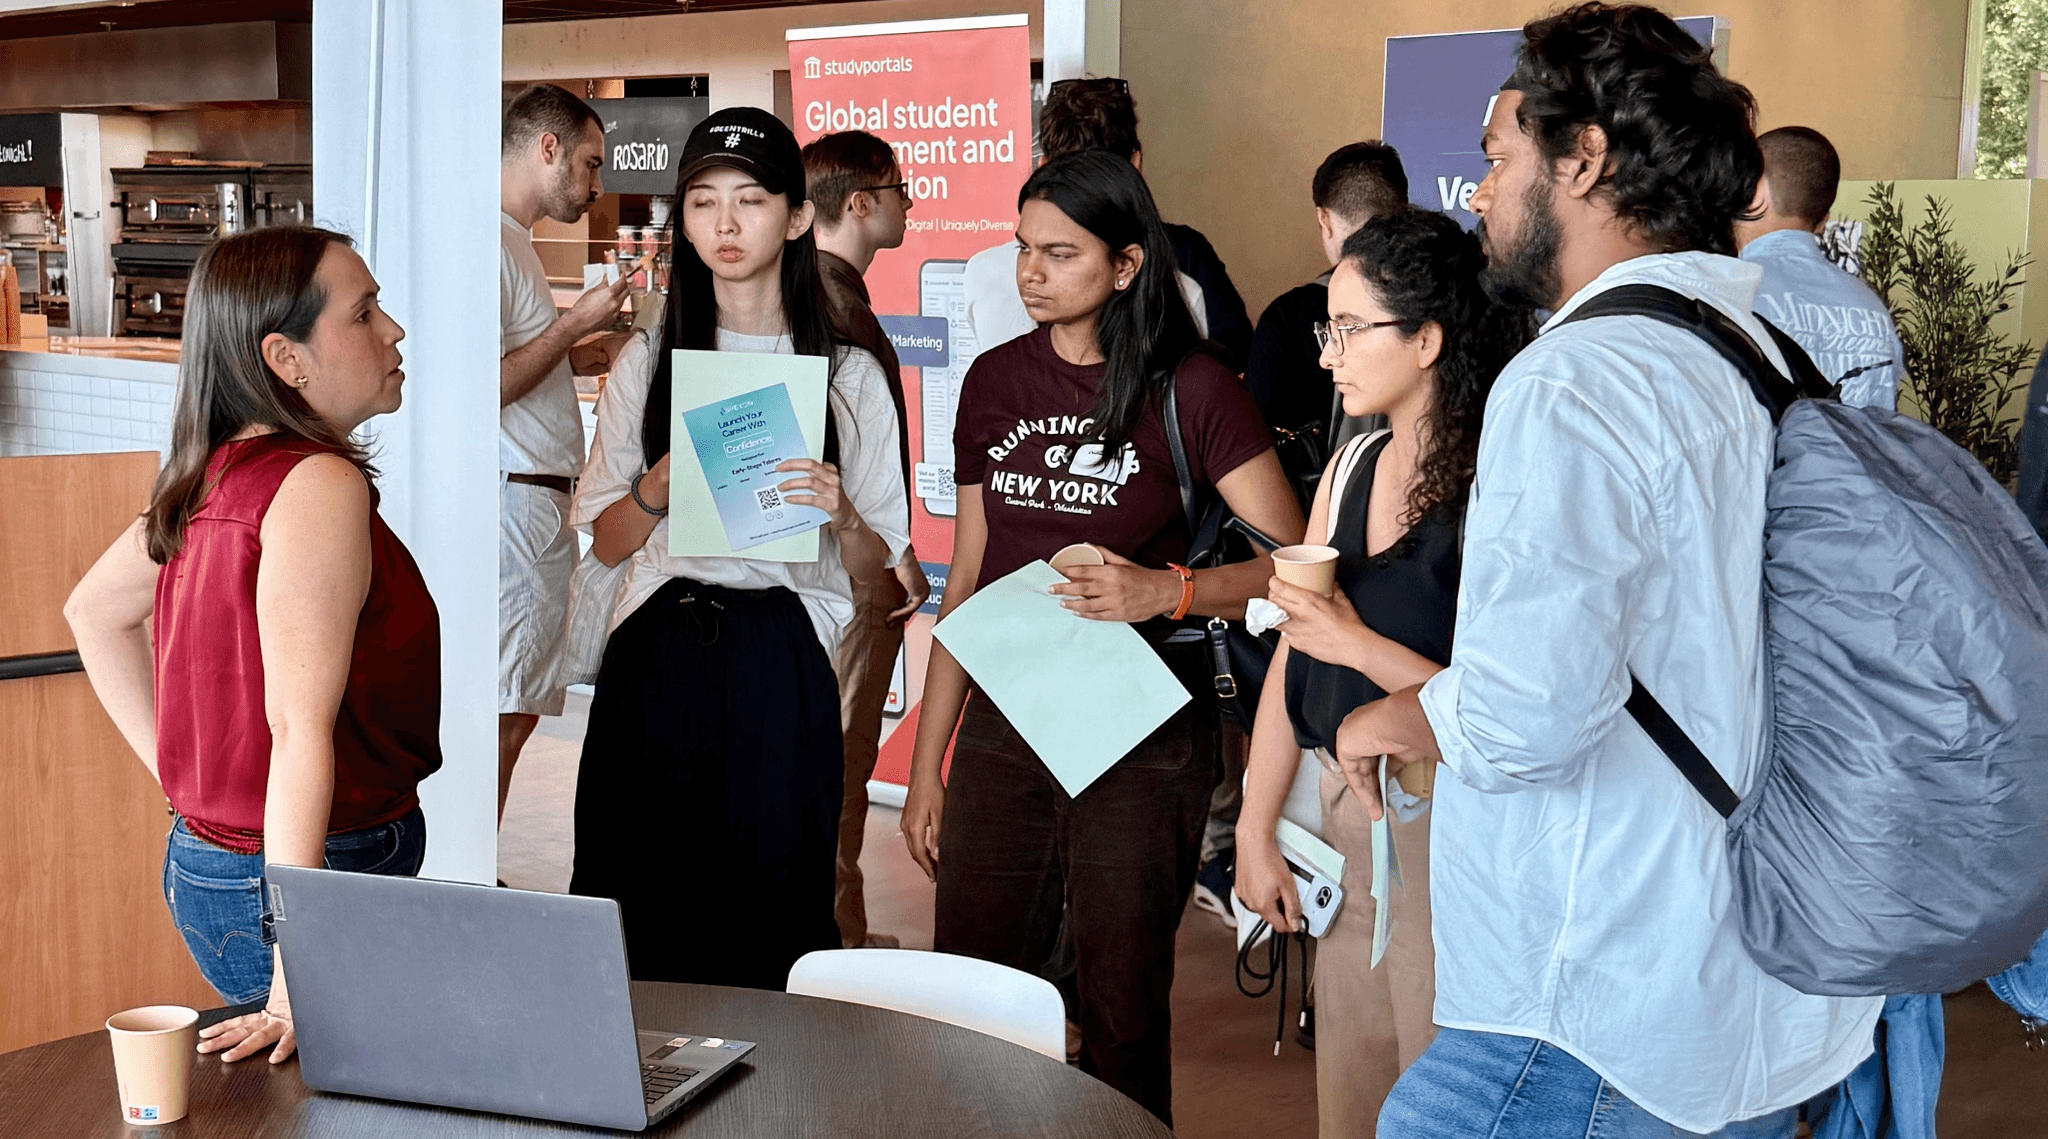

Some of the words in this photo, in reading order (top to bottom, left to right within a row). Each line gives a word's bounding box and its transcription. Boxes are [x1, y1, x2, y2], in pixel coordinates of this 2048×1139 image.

[824, 56, 913, 77] studyportals
[805, 98, 888, 132] Global
[893, 96, 998, 130] student
[962, 130, 1014, 164] and
[903, 169, 948, 200] ion
[1437, 176, 1479, 211] Ve
[941, 219, 980, 234] Uniquely
[892, 334, 943, 352] Marketing
[991, 470, 1042, 498] NEW
[1048, 479, 1119, 507] YORK
